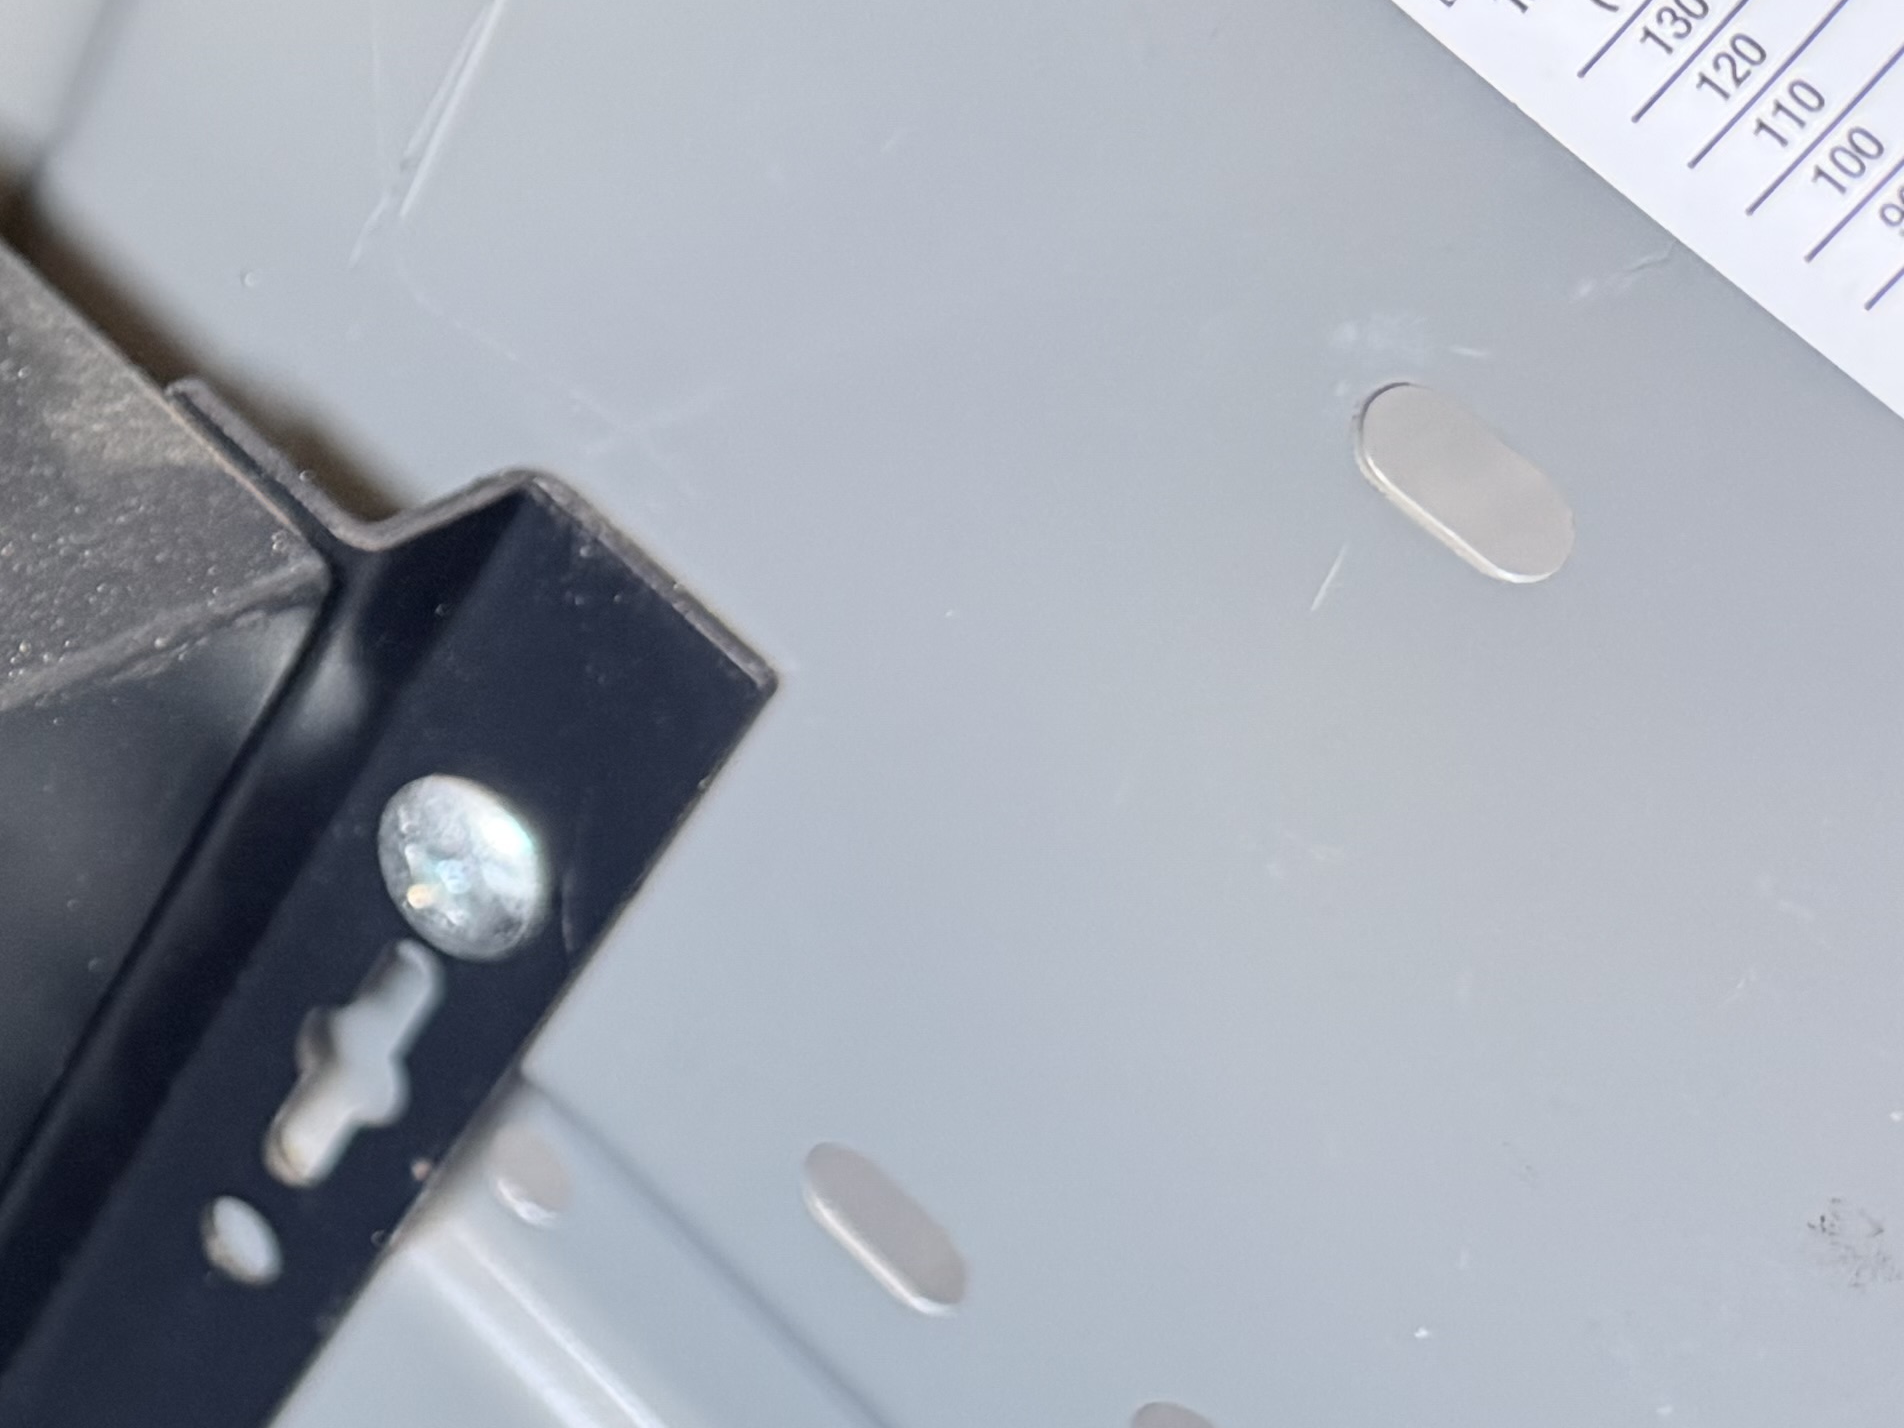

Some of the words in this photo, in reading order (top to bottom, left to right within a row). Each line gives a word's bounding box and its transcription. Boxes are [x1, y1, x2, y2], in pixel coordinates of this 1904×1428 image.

[1696, 33, 1767, 101] 120
[1754, 80, 1825, 147] 110
[1812, 127, 1884, 194] 100
